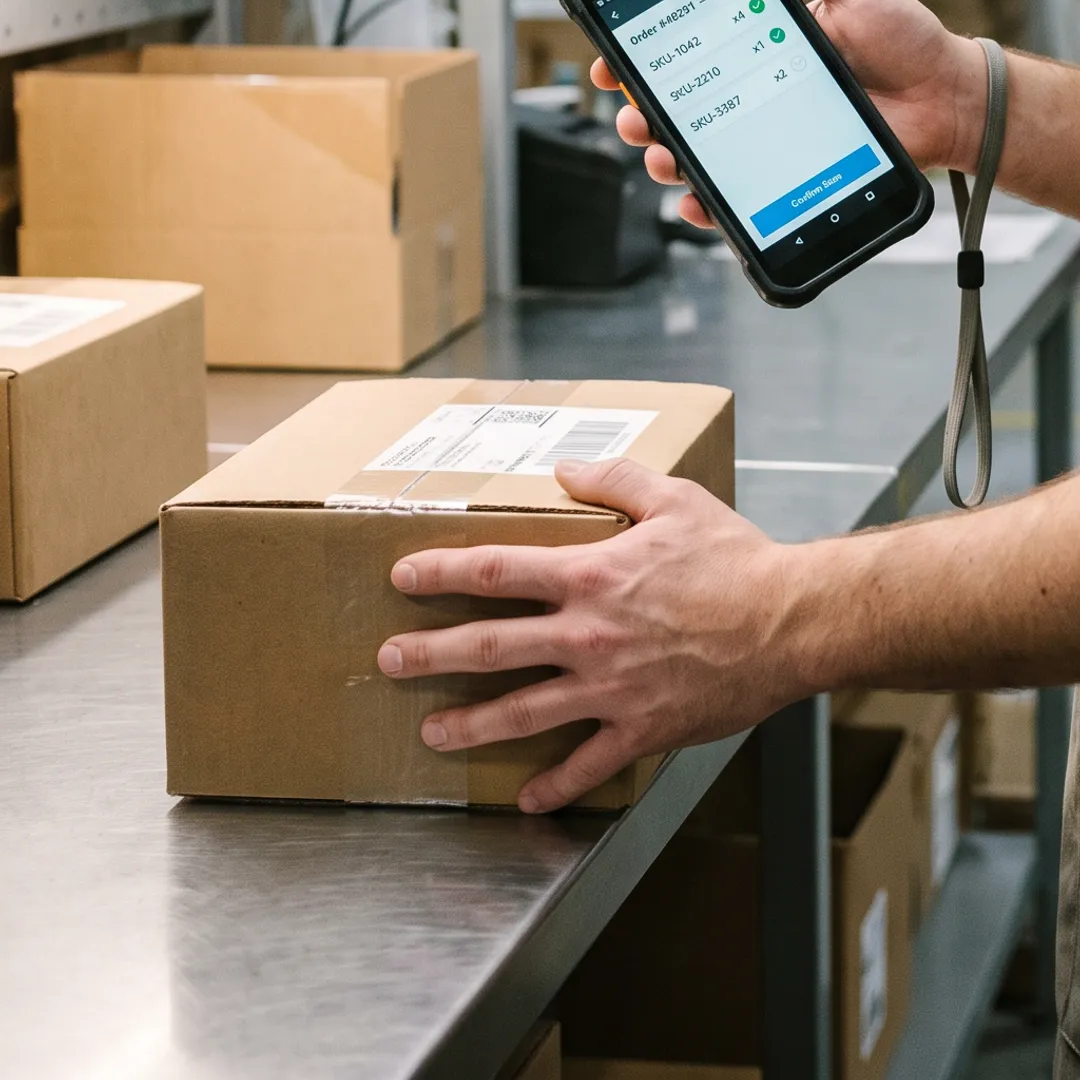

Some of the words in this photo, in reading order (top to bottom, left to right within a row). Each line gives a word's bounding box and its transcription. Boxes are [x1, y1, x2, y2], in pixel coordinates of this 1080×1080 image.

[629, 25, 658, 46] Order
[649, 37, 702, 72] SKU-1042
[732, 10, 746, 24] x4
[669, 66, 721, 102] SKU-2210
[752, 40, 765, 54] x1
[690, 94, 741, 132] SKU-3387
[773, 68, 788, 83] x2
